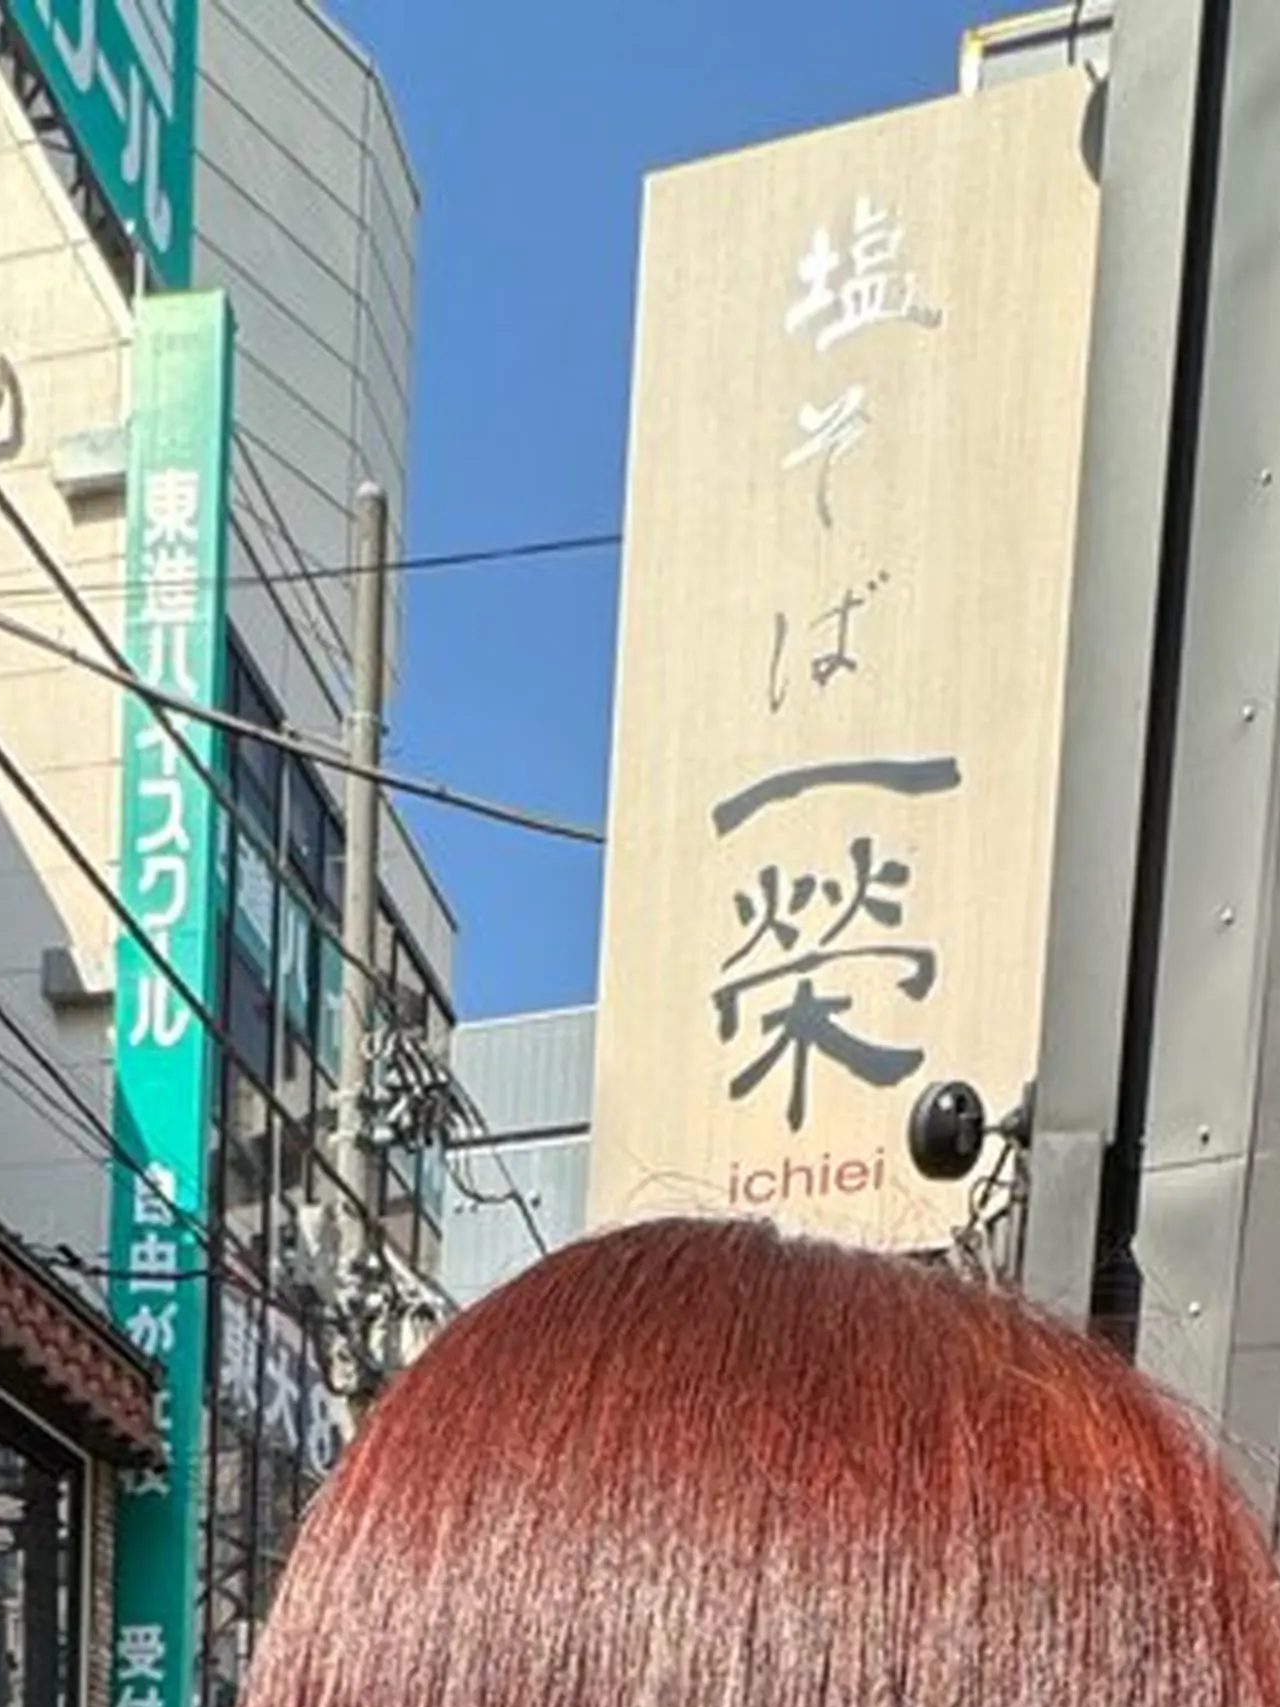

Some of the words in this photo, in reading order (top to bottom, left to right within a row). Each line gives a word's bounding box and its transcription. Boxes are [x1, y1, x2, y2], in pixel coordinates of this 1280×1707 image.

[782, 195, 943, 714] 塩そば
[128, 467, 199, 1047] 東進ハイスクール
[728, 1147, 886, 1205] ichiei
